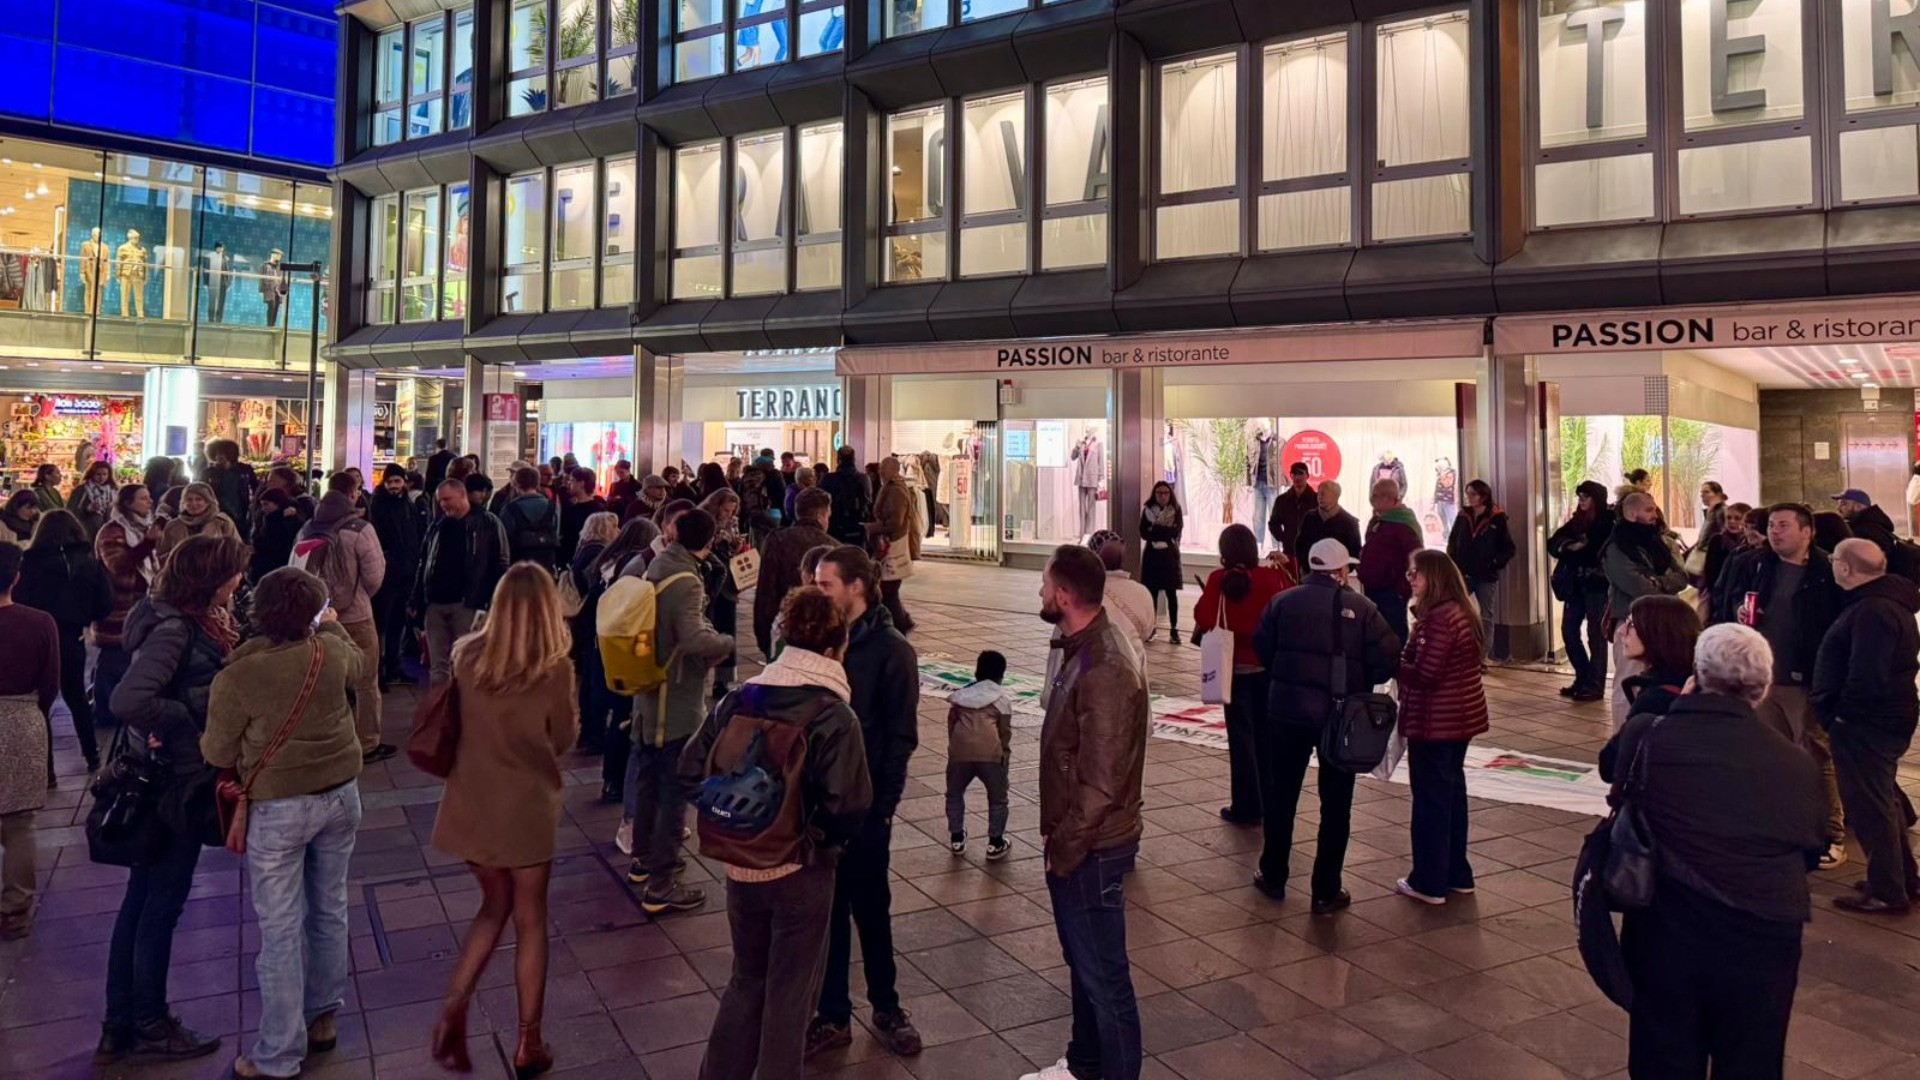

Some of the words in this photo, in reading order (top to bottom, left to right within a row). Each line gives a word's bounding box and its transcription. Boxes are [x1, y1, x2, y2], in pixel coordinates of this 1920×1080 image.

[1552, 317, 1715, 348] PASSION
[1733, 321, 1779, 342] bar
[1786, 319, 1806, 340] &
[997, 345, 1092, 368] PASSION
[1102, 349, 1129, 365] bar
[1132, 347, 1144, 364] &
[1148, 345, 1230, 363] ristorante
